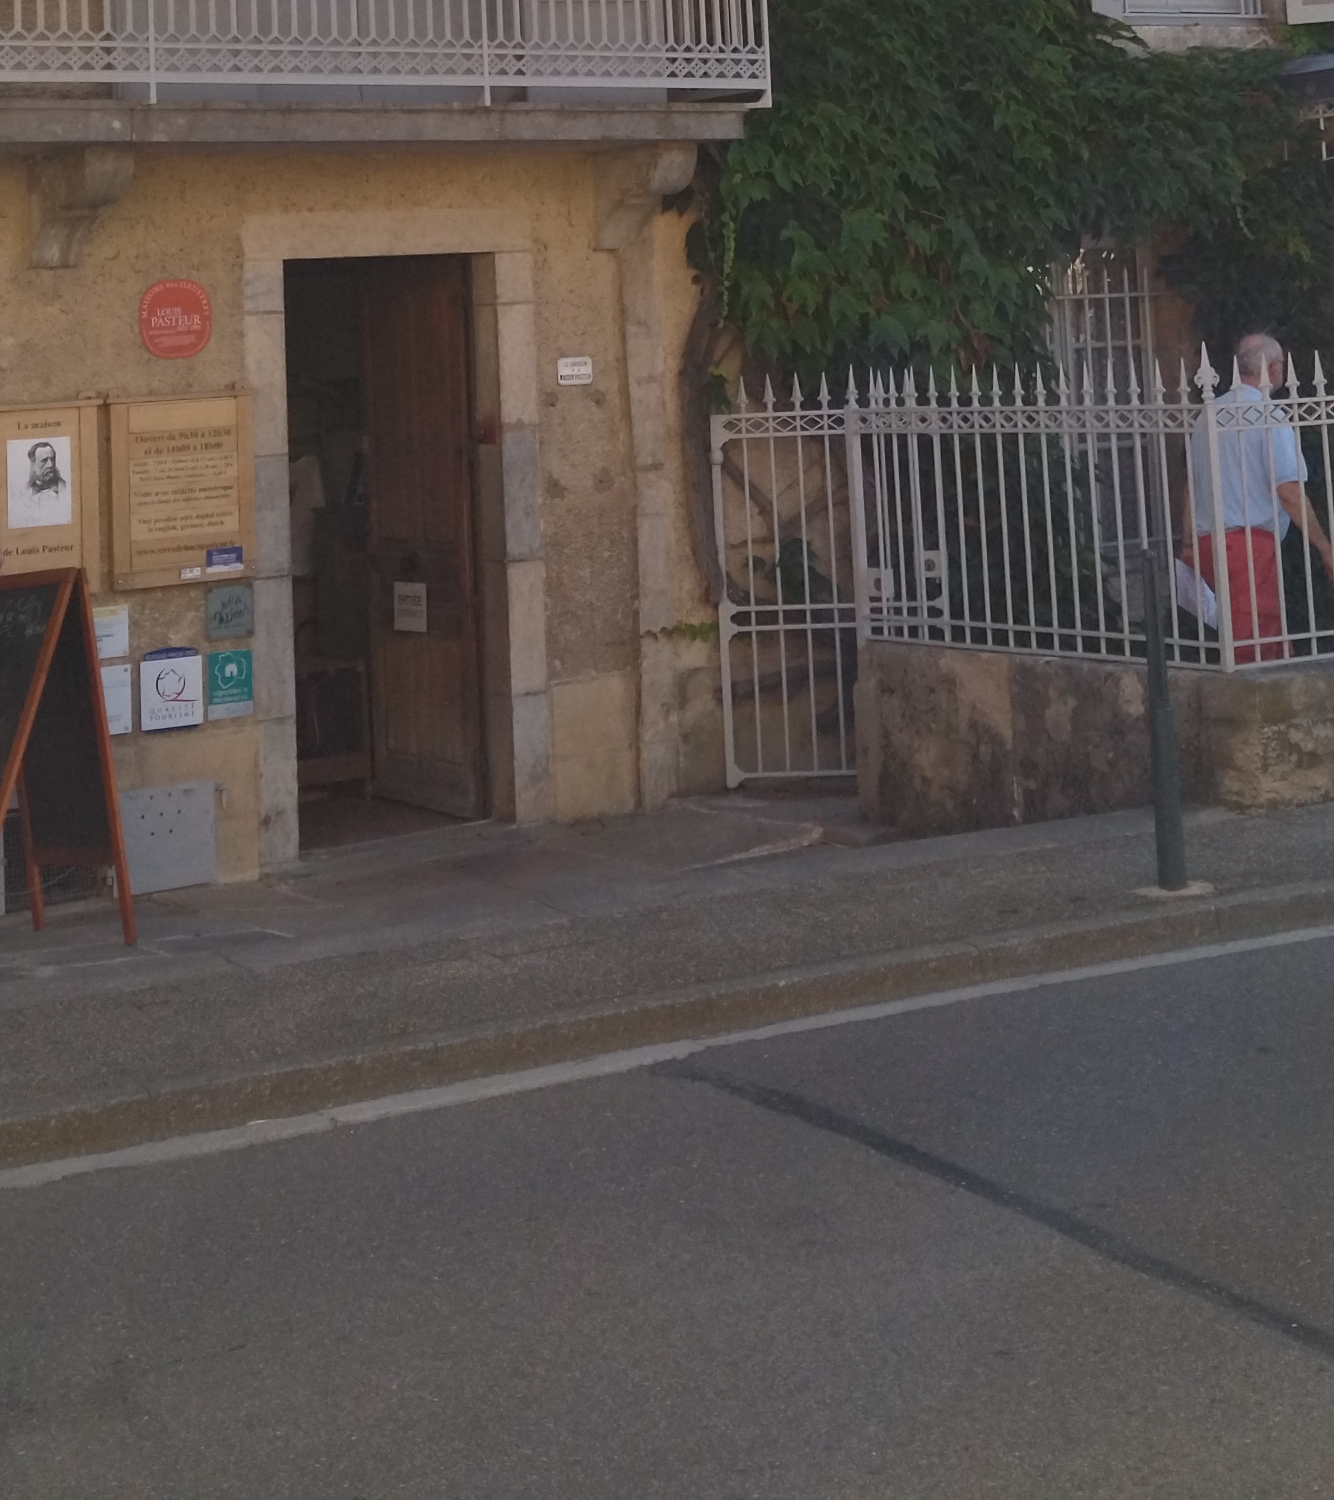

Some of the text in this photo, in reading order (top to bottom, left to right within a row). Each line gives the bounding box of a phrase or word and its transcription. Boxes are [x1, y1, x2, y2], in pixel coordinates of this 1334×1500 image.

[157, 307, 182, 316] LOUIS
[151, 314, 202, 327] PASTEUR
[17, 420, 61, 430] La maison
[135, 435, 165, 444] Ouvert
[2, 544, 74, 557] de Louis Pasteur
[148, 710, 195, 721] TOURISME
